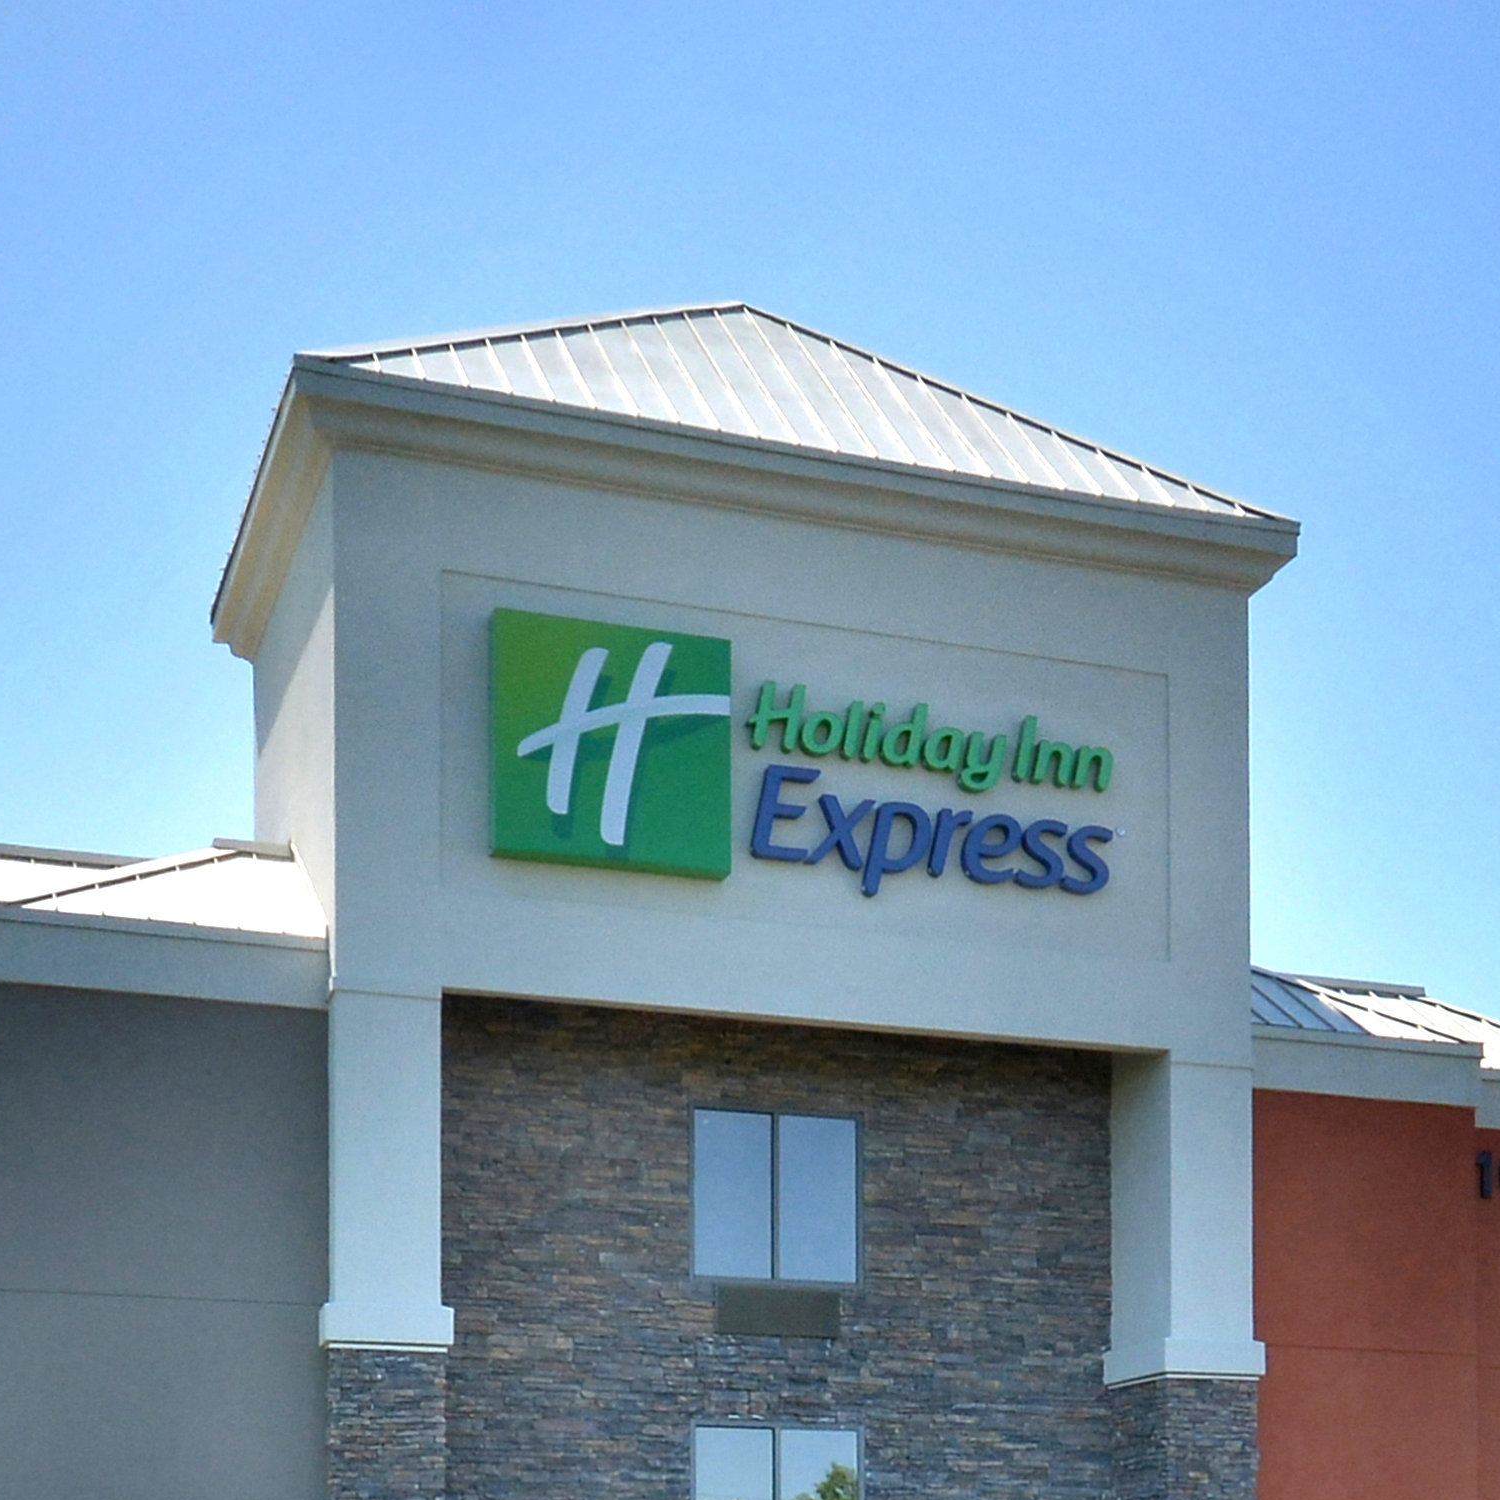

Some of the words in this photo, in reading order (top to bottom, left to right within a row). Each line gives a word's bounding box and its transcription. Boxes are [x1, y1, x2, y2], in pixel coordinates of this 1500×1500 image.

[747, 680, 1008, 792] Holiday
[1012, 715, 1115, 792] Inn
[750, 764, 1114, 897] Express
